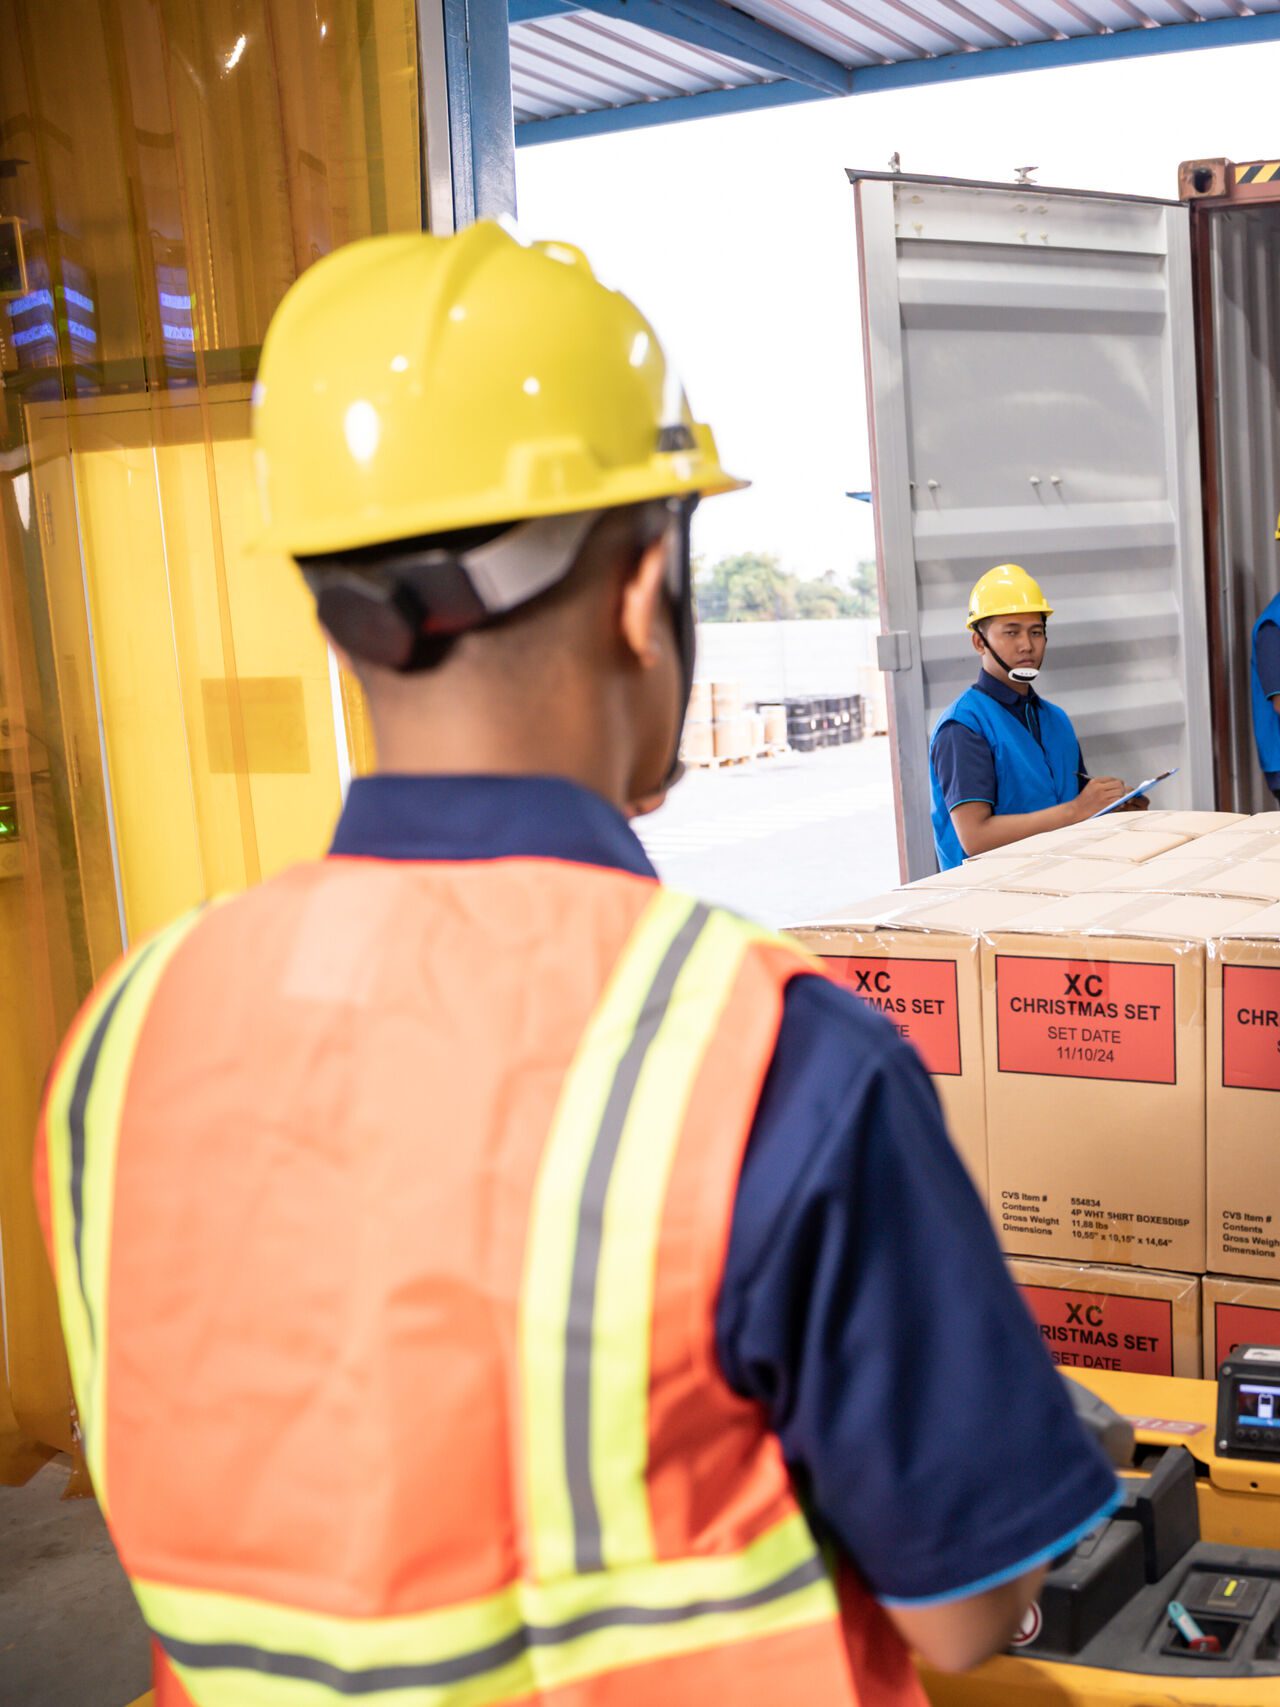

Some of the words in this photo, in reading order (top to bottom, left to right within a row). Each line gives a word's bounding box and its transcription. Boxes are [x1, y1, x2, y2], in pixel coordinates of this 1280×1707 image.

[855, 970, 892, 994] XC
[1064, 974, 1103, 997] XC
[912, 999, 944, 1014] SET
[1010, 997, 1118, 1018] CHRISTMAS
[1124, 1004, 1160, 1021] SET
[1048, 1026, 1077, 1040] SET
[1081, 1028, 1121, 1044] DATE
[1057, 1047, 1114, 1062] 11/10/24
[1001, 1191, 1020, 1200] CVS
[1022, 1193, 1040, 1202] Item
[1070, 1197, 1100, 1207] 554834
[1002, 1202, 1040, 1213] Contents
[1002, 1212, 1028, 1222] Gross
[1029, 1216, 1059, 1226] Weight
[1084, 1210, 1104, 1219] WHT
[1106, 1211, 1134, 1222] SHIRT
[1136, 1215, 1190, 1226] BOXESDISP
[1222, 1210, 1242, 1220] CVS
[1244, 1213, 1263, 1222] Item
[1003, 1223, 1052, 1235] Dimensions
[1095, 1221, 1108, 1233] lbs
[1222, 1222, 1263, 1234] Contents
[1222, 1233, 1250, 1244] Gross
[1222, 1244, 1276, 1258] Dimensions
[1066, 1303, 1103, 1327] XC
[1123, 1334, 1159, 1352] SET
[1083, 1355, 1122, 1372] DATE
